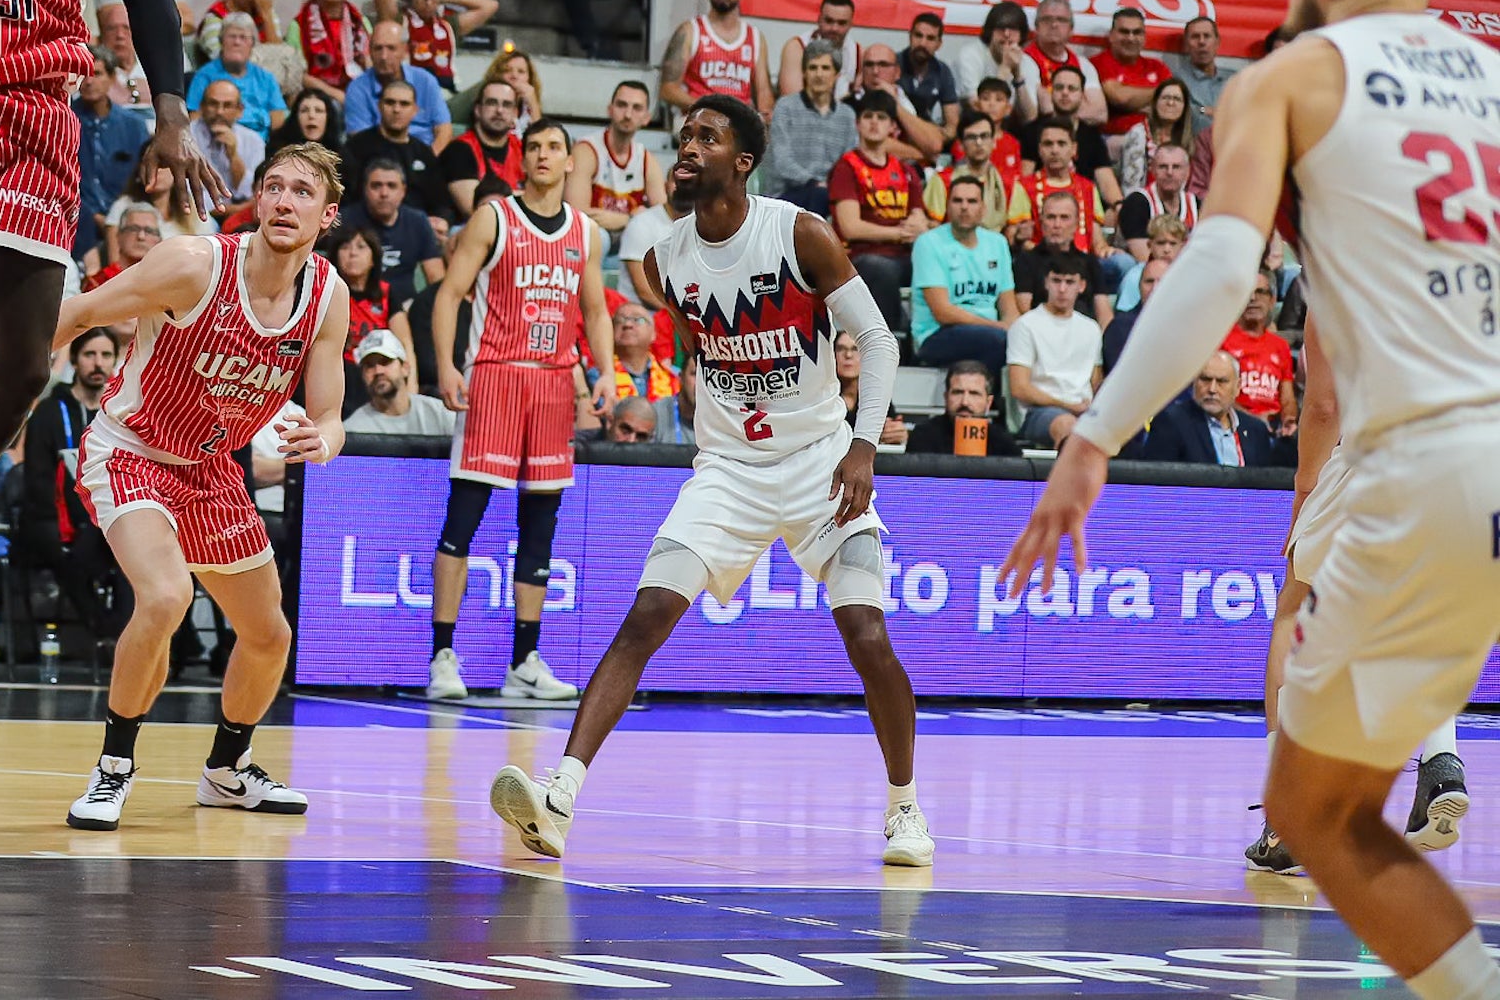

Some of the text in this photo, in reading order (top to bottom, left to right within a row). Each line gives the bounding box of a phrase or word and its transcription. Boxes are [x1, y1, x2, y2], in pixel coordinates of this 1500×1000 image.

[700, 60, 752, 84] UCAM
[514, 262, 581, 296] UCAM
[529, 322, 558, 353] 99
[697, 325, 805, 363] BASKONIA
[193, 352, 296, 394] UCAM
[205, 382, 266, 407] MURCIA
[200, 423, 228, 455] 2
[739, 407, 774, 442] 2
[205, 511, 258, 545] INVERSUS
[976, 563, 1155, 633] para
[226, 947, 1396, 992] INVERS
